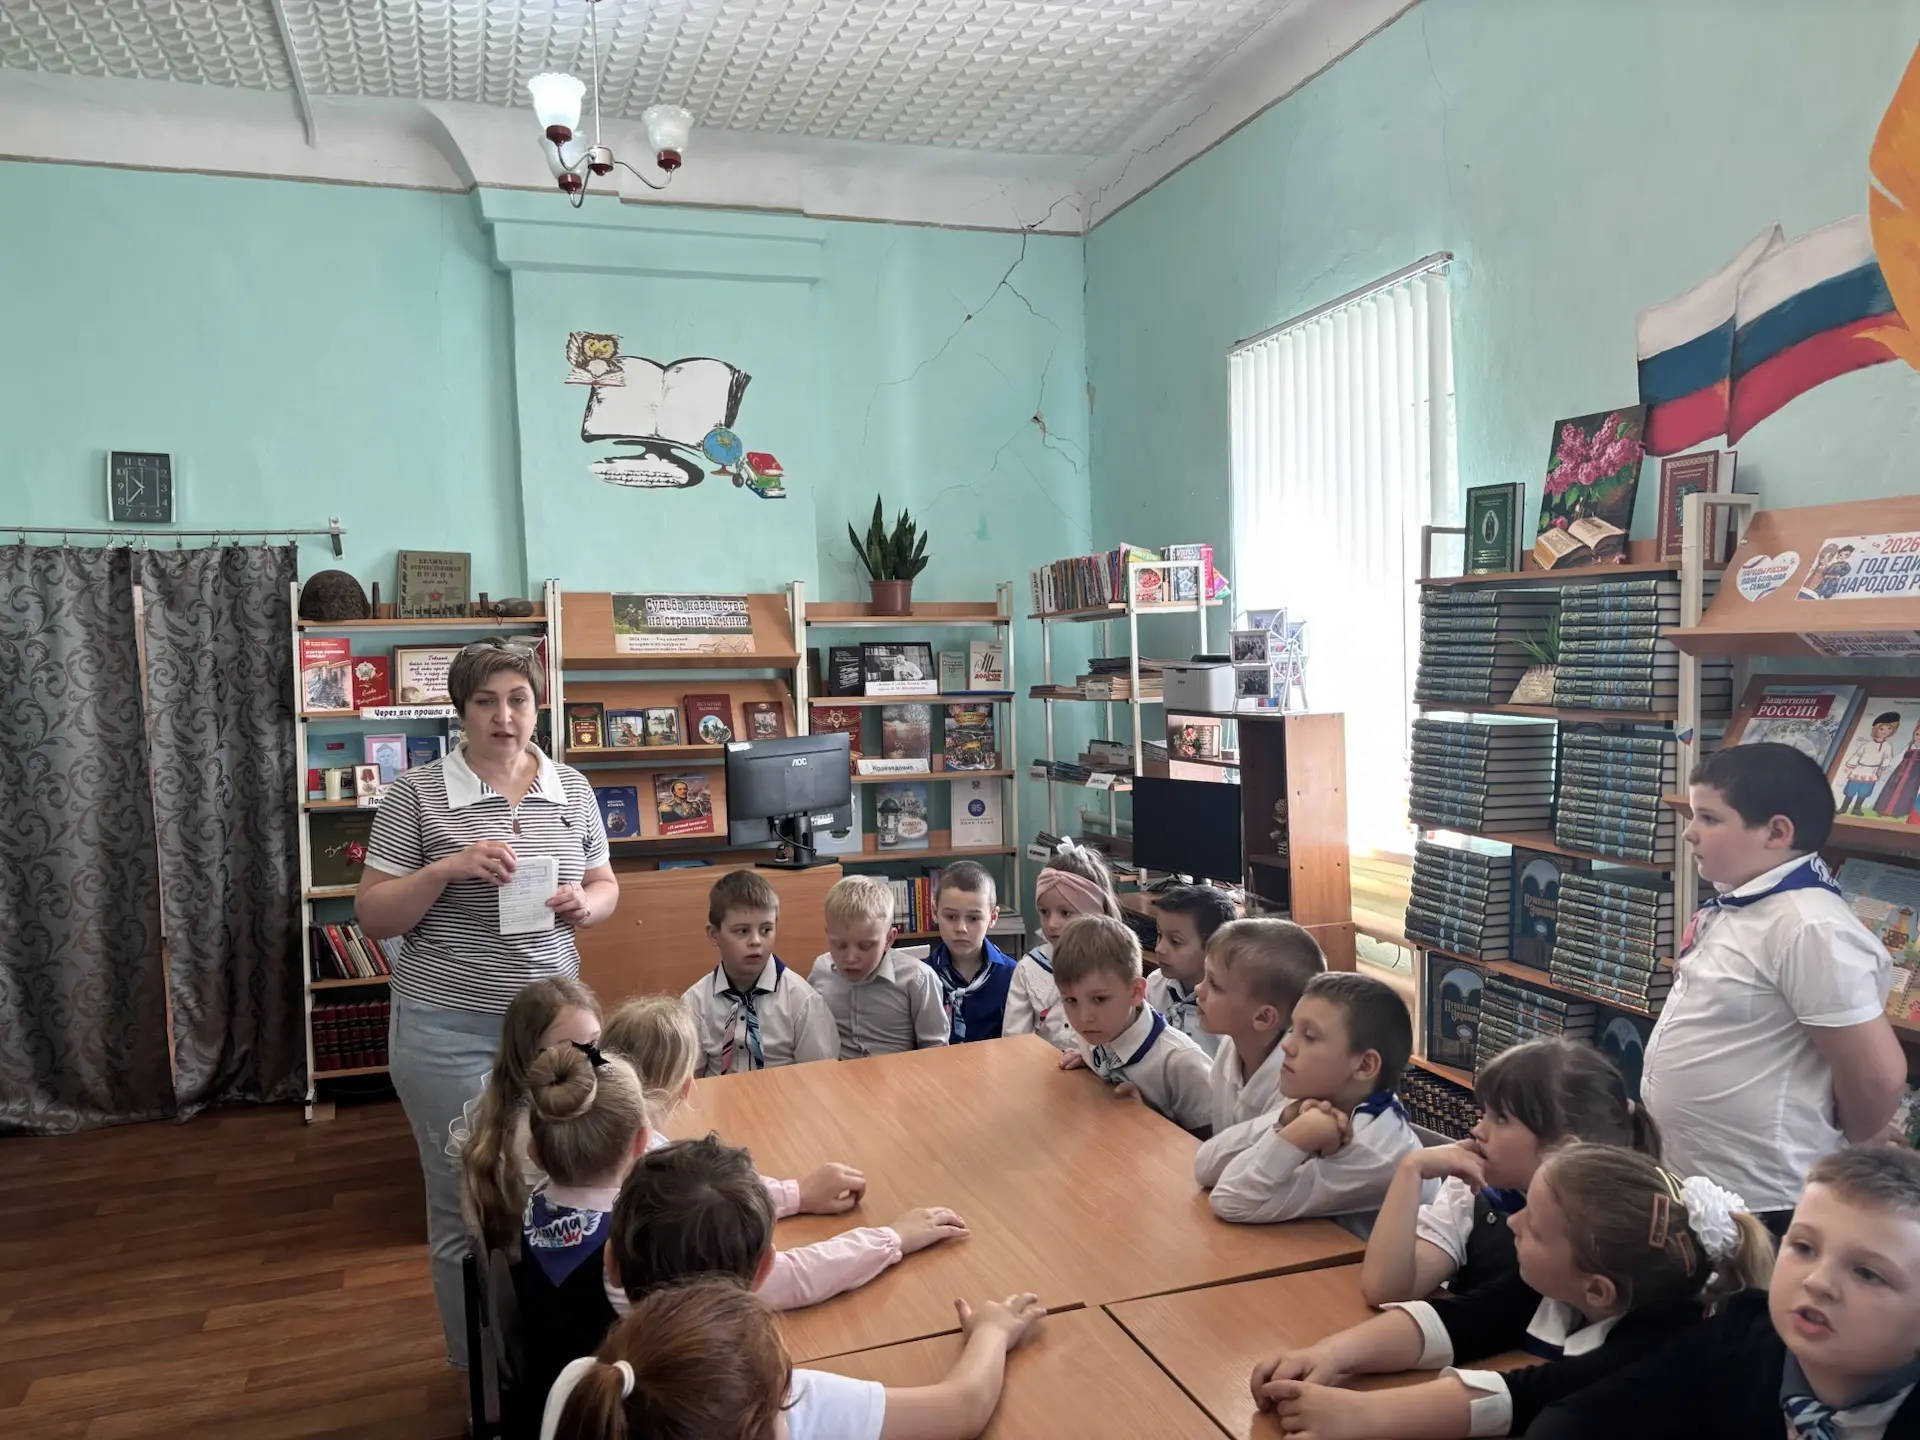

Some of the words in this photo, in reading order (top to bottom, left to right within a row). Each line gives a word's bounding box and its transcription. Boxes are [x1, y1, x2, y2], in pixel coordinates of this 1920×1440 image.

[1880, 536, 1920, 554] 2026
[1856, 557, 1890, 575] ГОД
[1837, 575, 1909, 593] НАРОДОВ
[646, 598, 683, 612] Судьба
[686, 600, 745, 611] казачества
[648, 616, 661, 626] на
[664, 616, 720, 628] страницах
[723, 616, 748, 626] книг
[1763, 696, 1818, 705] Защитники
[374, 709, 397, 717] Через
[414, 708, 443, 717] прошли
[1757, 705, 1820, 717] РОССИИ
[792, 758, 807, 767] AOC
